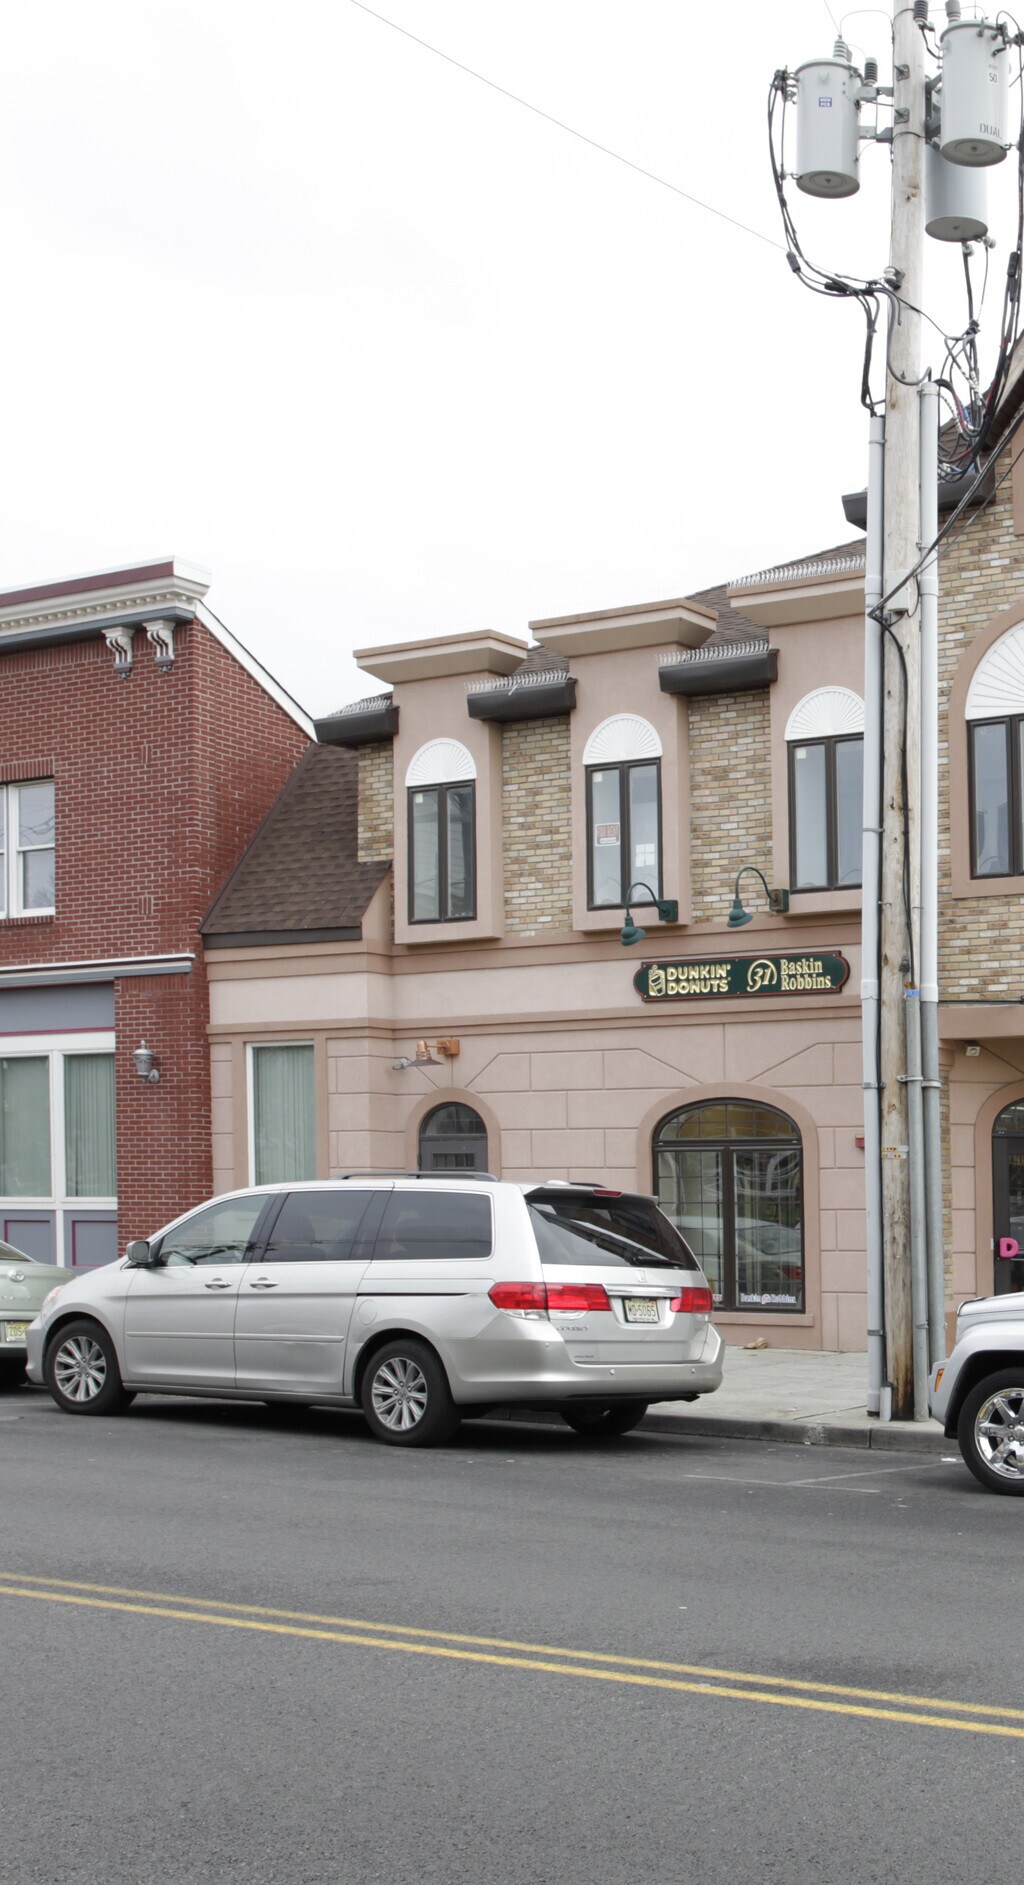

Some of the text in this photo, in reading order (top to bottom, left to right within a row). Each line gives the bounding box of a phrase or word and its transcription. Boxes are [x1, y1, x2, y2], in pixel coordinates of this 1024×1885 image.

[989, 72, 998, 84] 50
[667, 963, 731, 980] DUNKIN'
[780, 958, 823, 975] Baskin
[747, 963, 775, 992] 31
[781, 974, 832, 991] Robbins
[667, 979, 729, 995] DONUTS
[999, 1237, 1019, 1258] D
